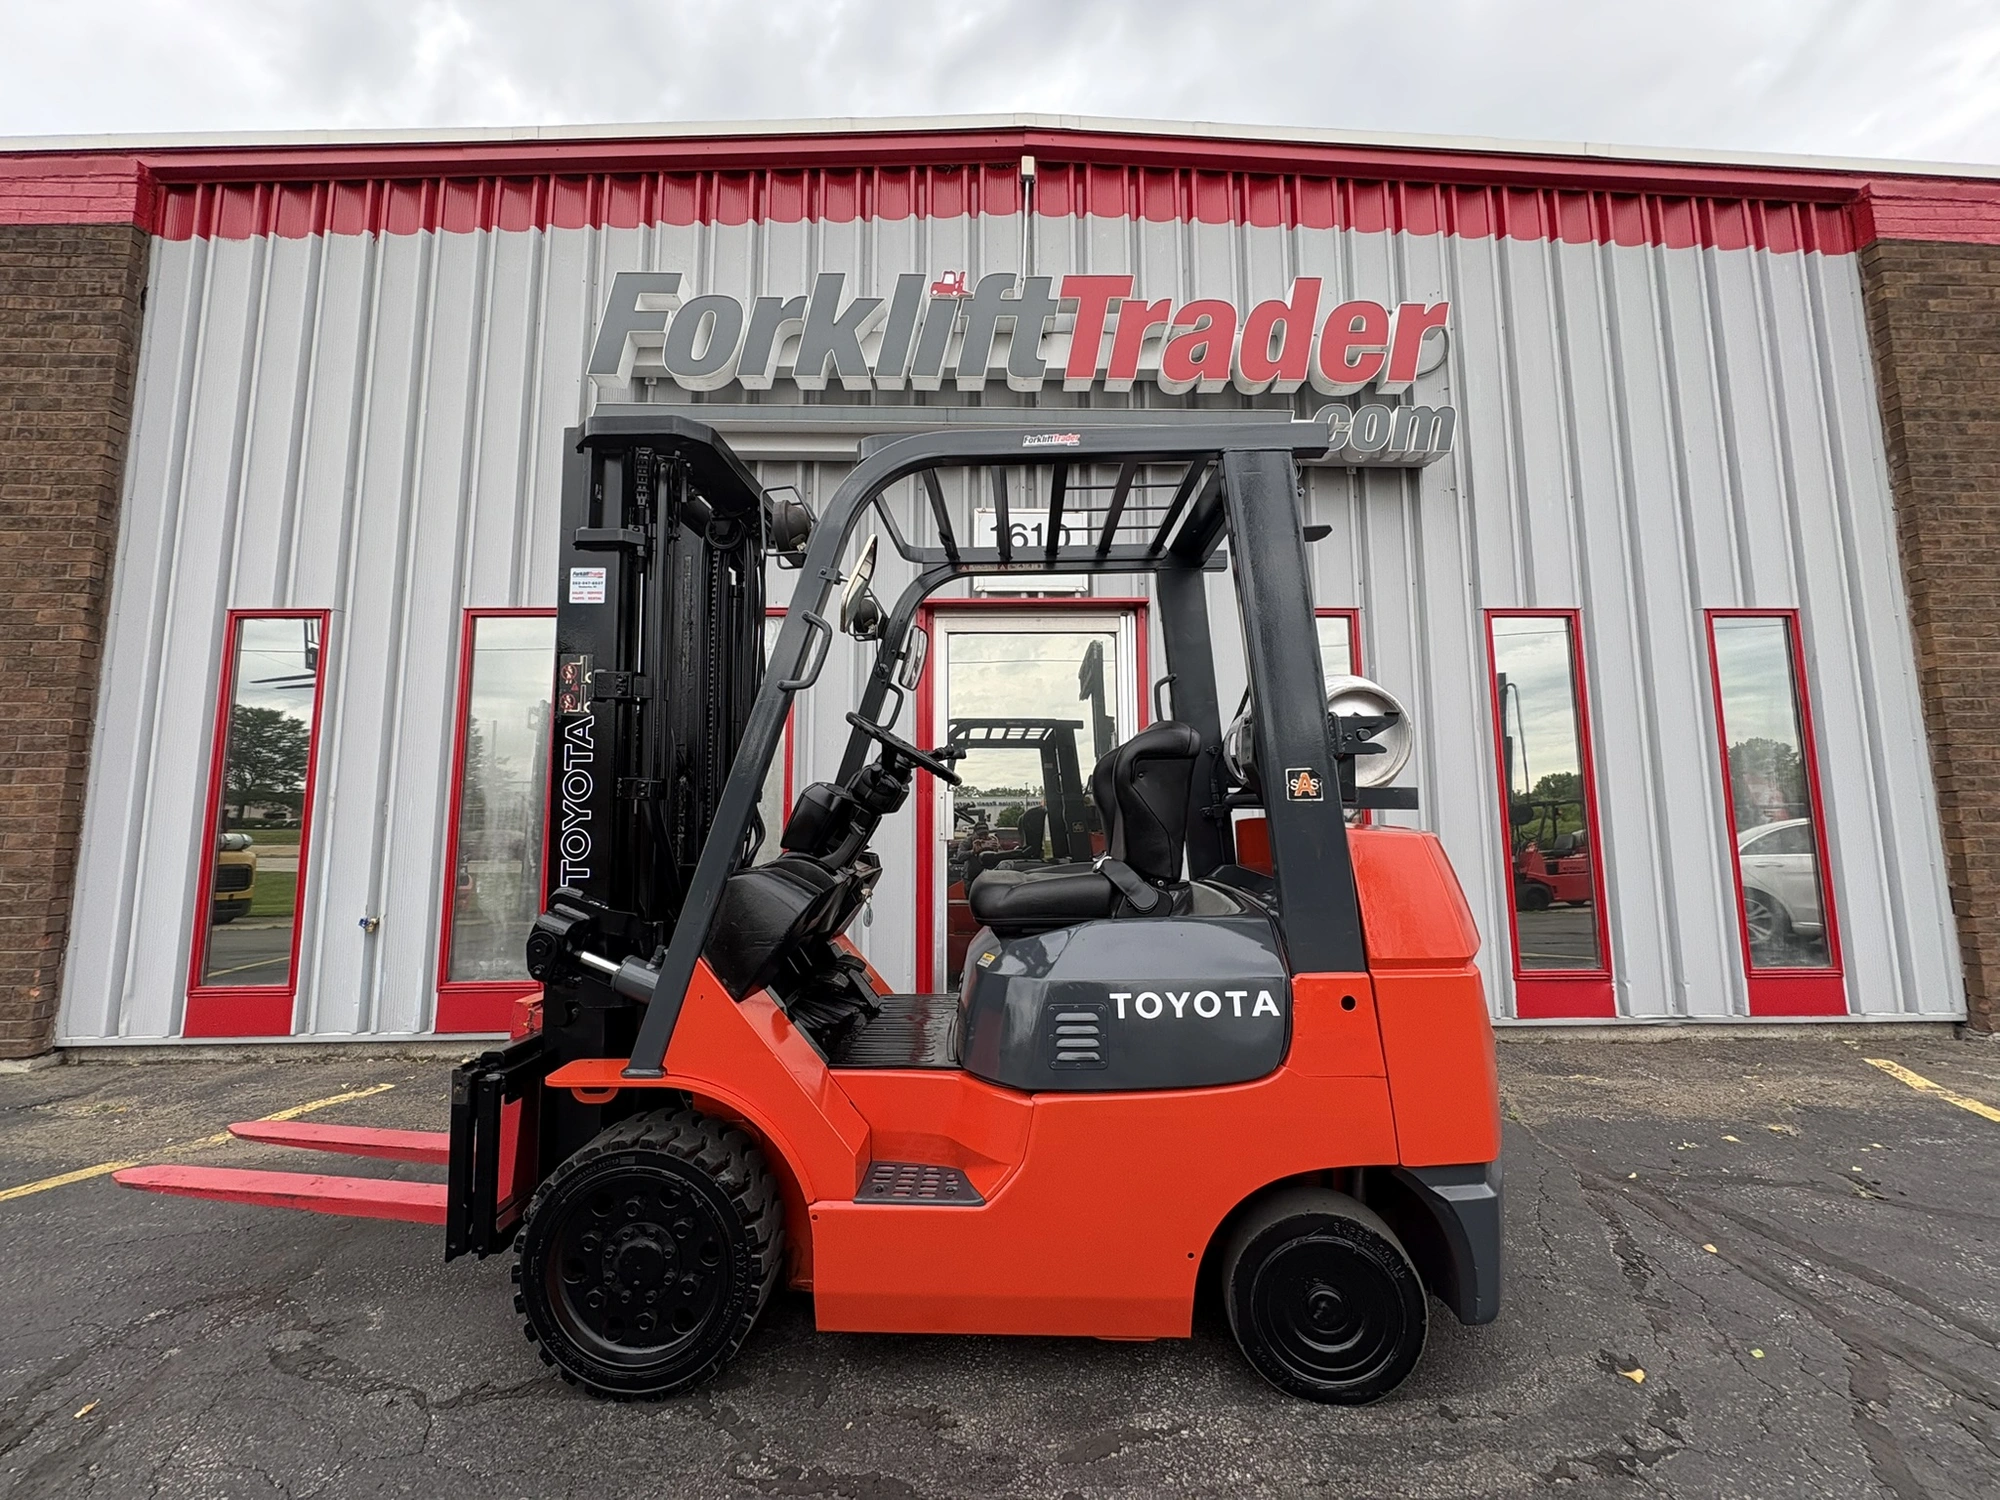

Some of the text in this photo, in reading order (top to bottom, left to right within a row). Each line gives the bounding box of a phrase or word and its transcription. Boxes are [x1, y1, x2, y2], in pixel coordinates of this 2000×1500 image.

[586, 271, 1450, 387] ForkliftTrader
[560, 715, 594, 887] TOYOTA
[1290, 772, 1319, 796] SAS
[1109, 990, 1281, 1020] TOYOTA
